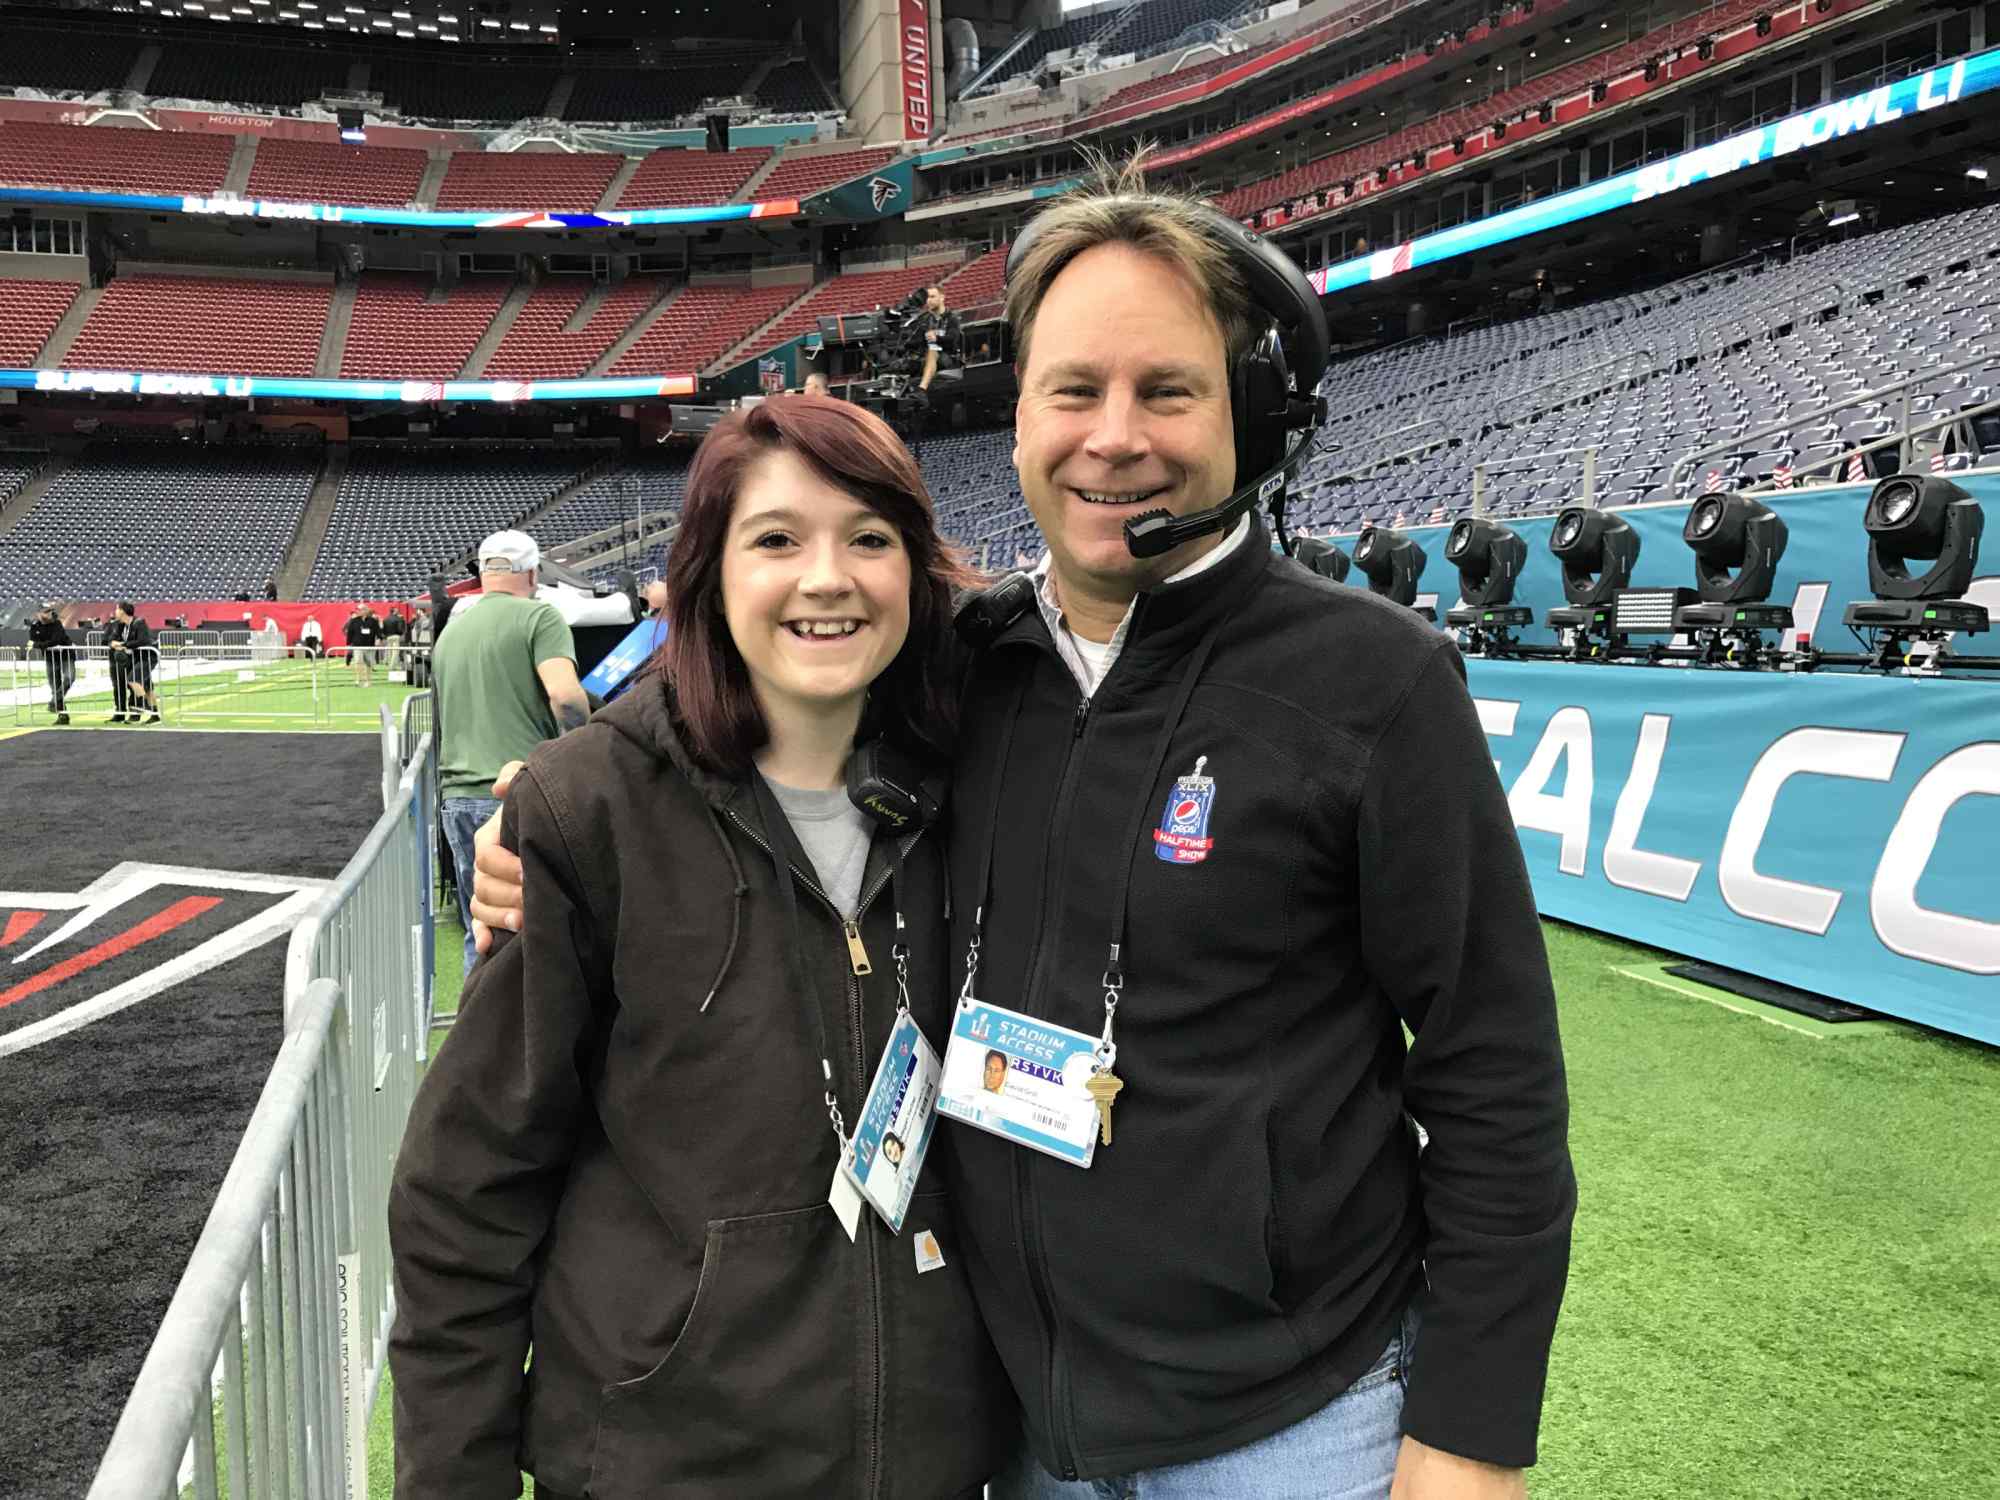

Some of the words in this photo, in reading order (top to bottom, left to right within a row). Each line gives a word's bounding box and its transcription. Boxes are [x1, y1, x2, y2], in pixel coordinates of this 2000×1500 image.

[905, 25, 928, 134] UNITED
[208, 115, 275, 128] HOUSTON
[1772, 86, 1904, 156] BOWL
[1916, 60, 1967, 111] LI
[1160, 832, 1207, 848] HALFTIME
[1171, 823, 1197, 834] pepsi
[1178, 849, 1206, 860] SHOW
[996, 1035, 1057, 1061] ACCESS
[999, 1020, 1067, 1050] STADIUM
[1010, 1057, 1064, 1085] RSTVK
[867, 1055, 897, 1128] STADIUM
[874, 1075, 899, 1135] ACCESS
